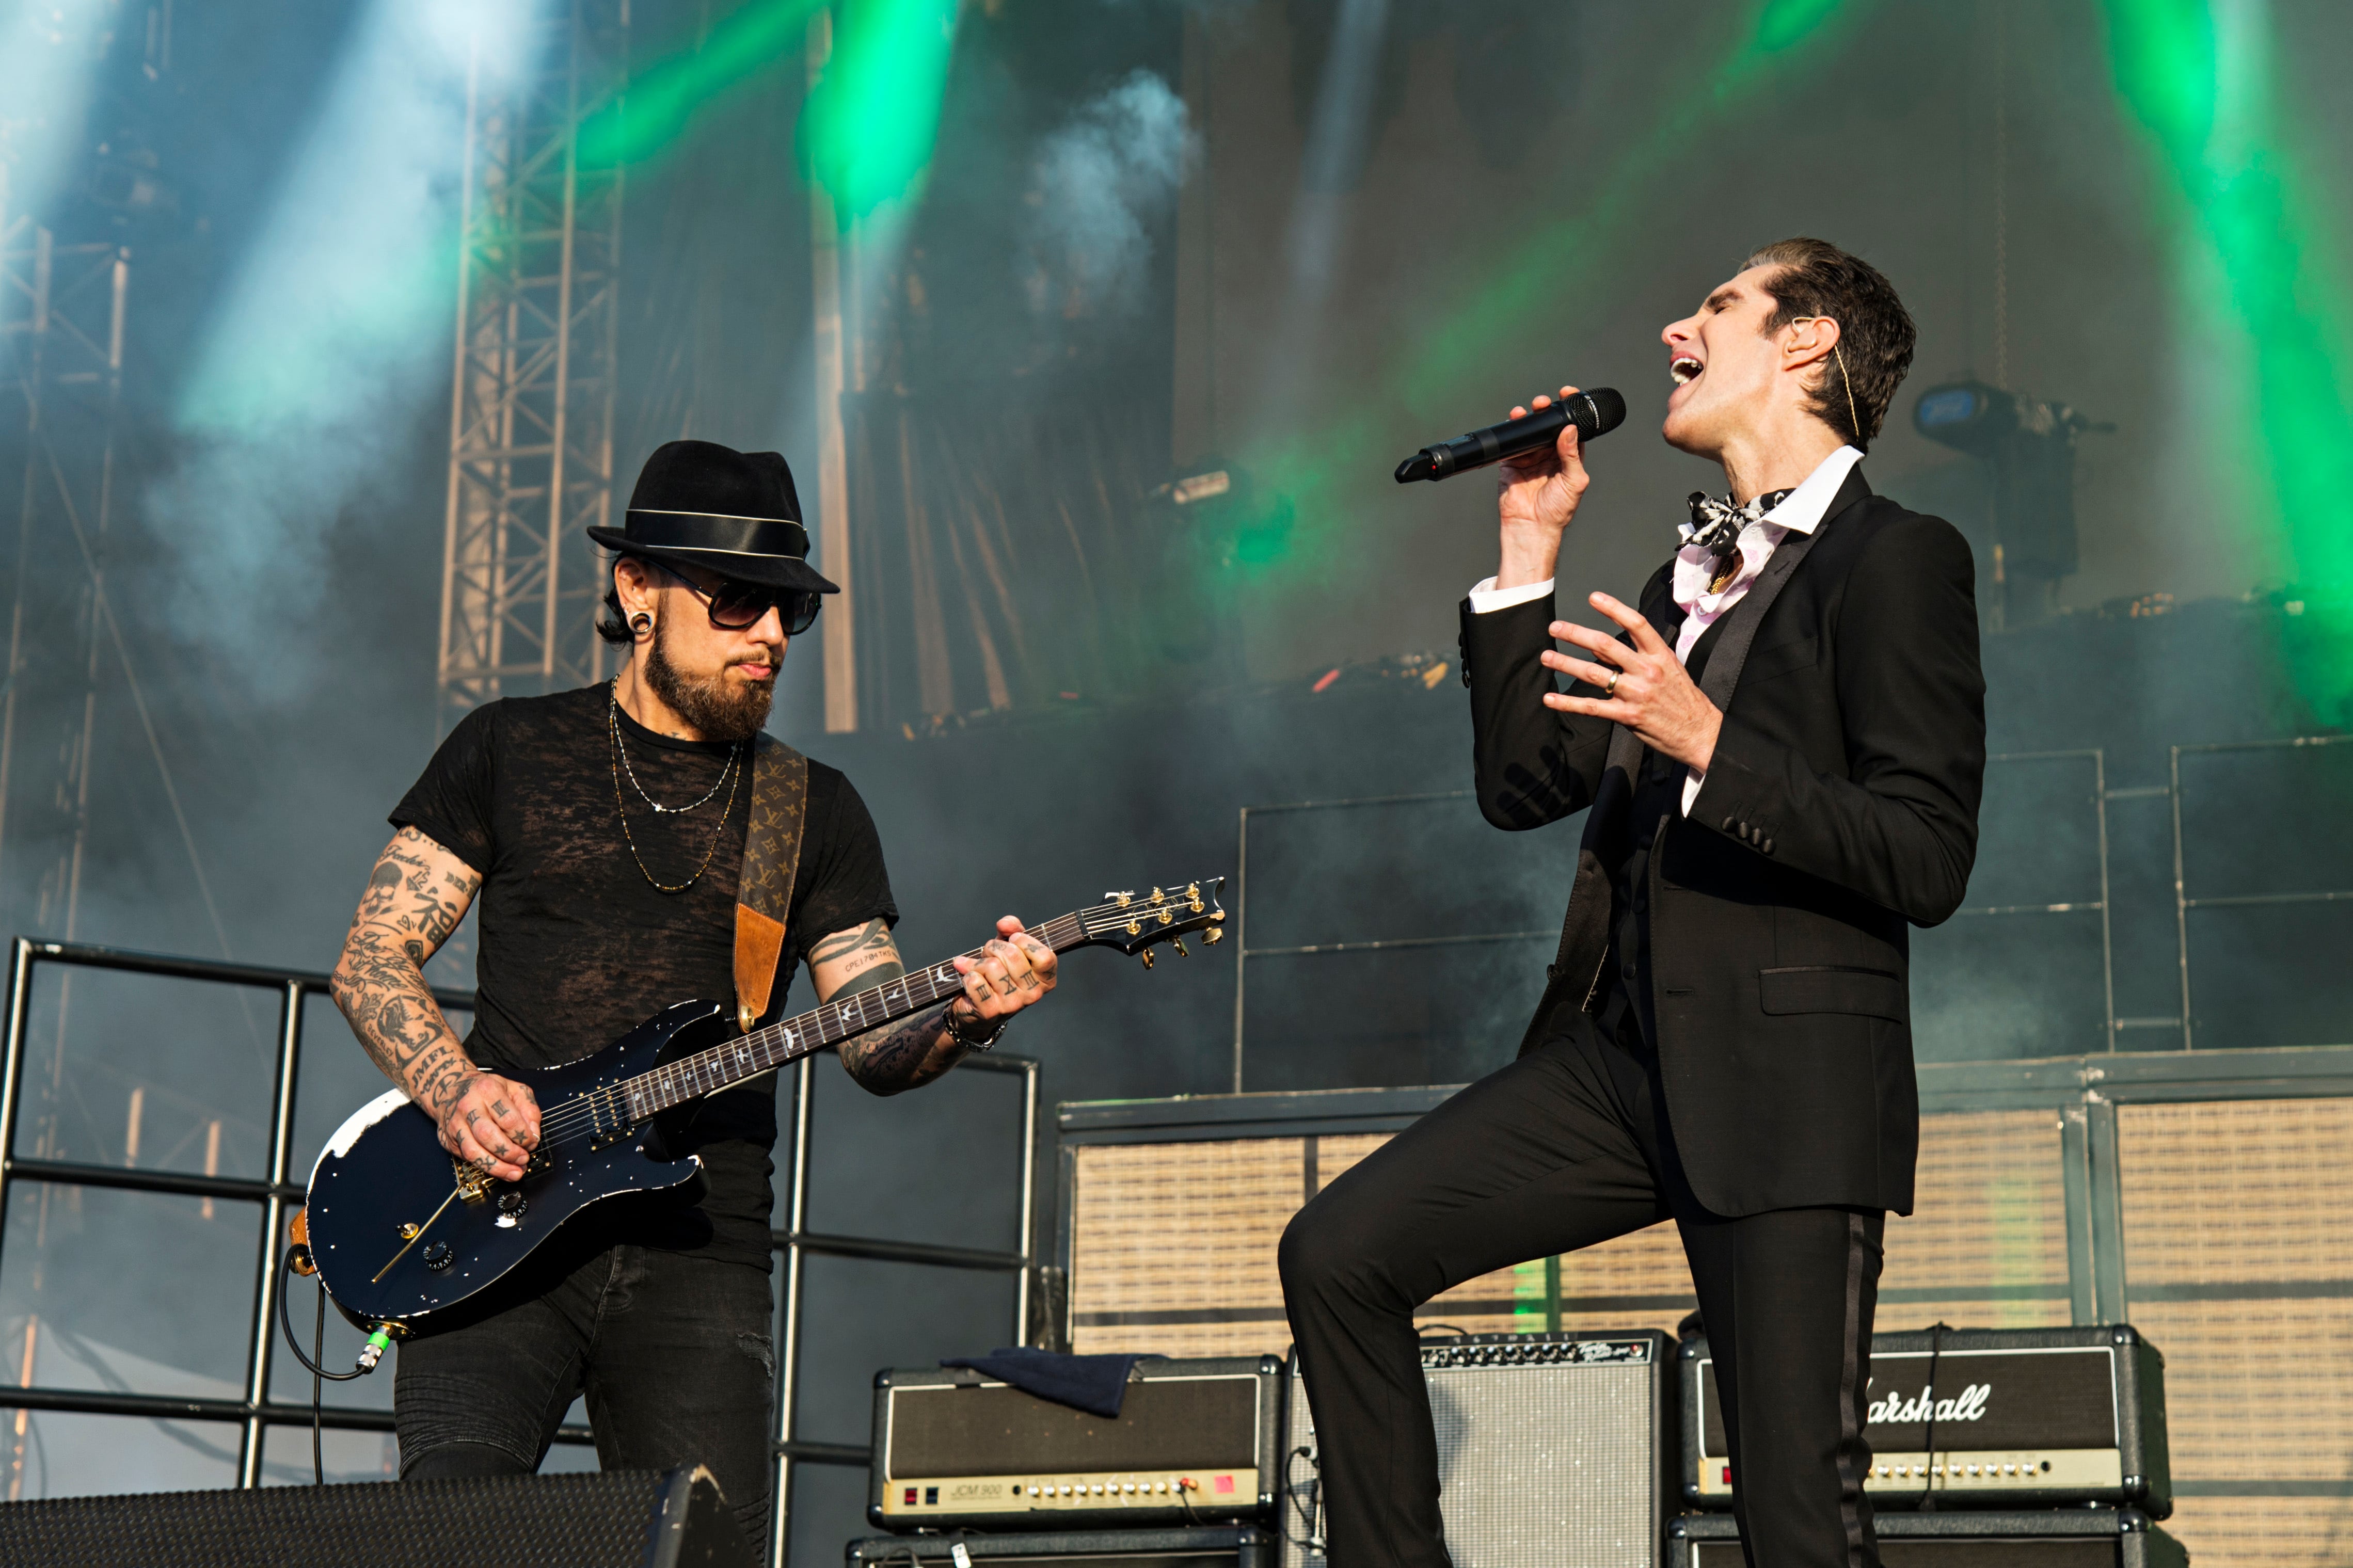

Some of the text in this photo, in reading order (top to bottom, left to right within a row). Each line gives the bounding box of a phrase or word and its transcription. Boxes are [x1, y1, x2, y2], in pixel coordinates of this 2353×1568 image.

[845, 950, 892, 972] CPE1704TKS
[999, 974, 1017, 995] X
[367, 1023, 393, 1057] BEVERLEY
[412, 1046, 454, 1089] JMFL
[1866, 1377, 1991, 1423] arshall
[951, 1485, 979, 1496] JCM
